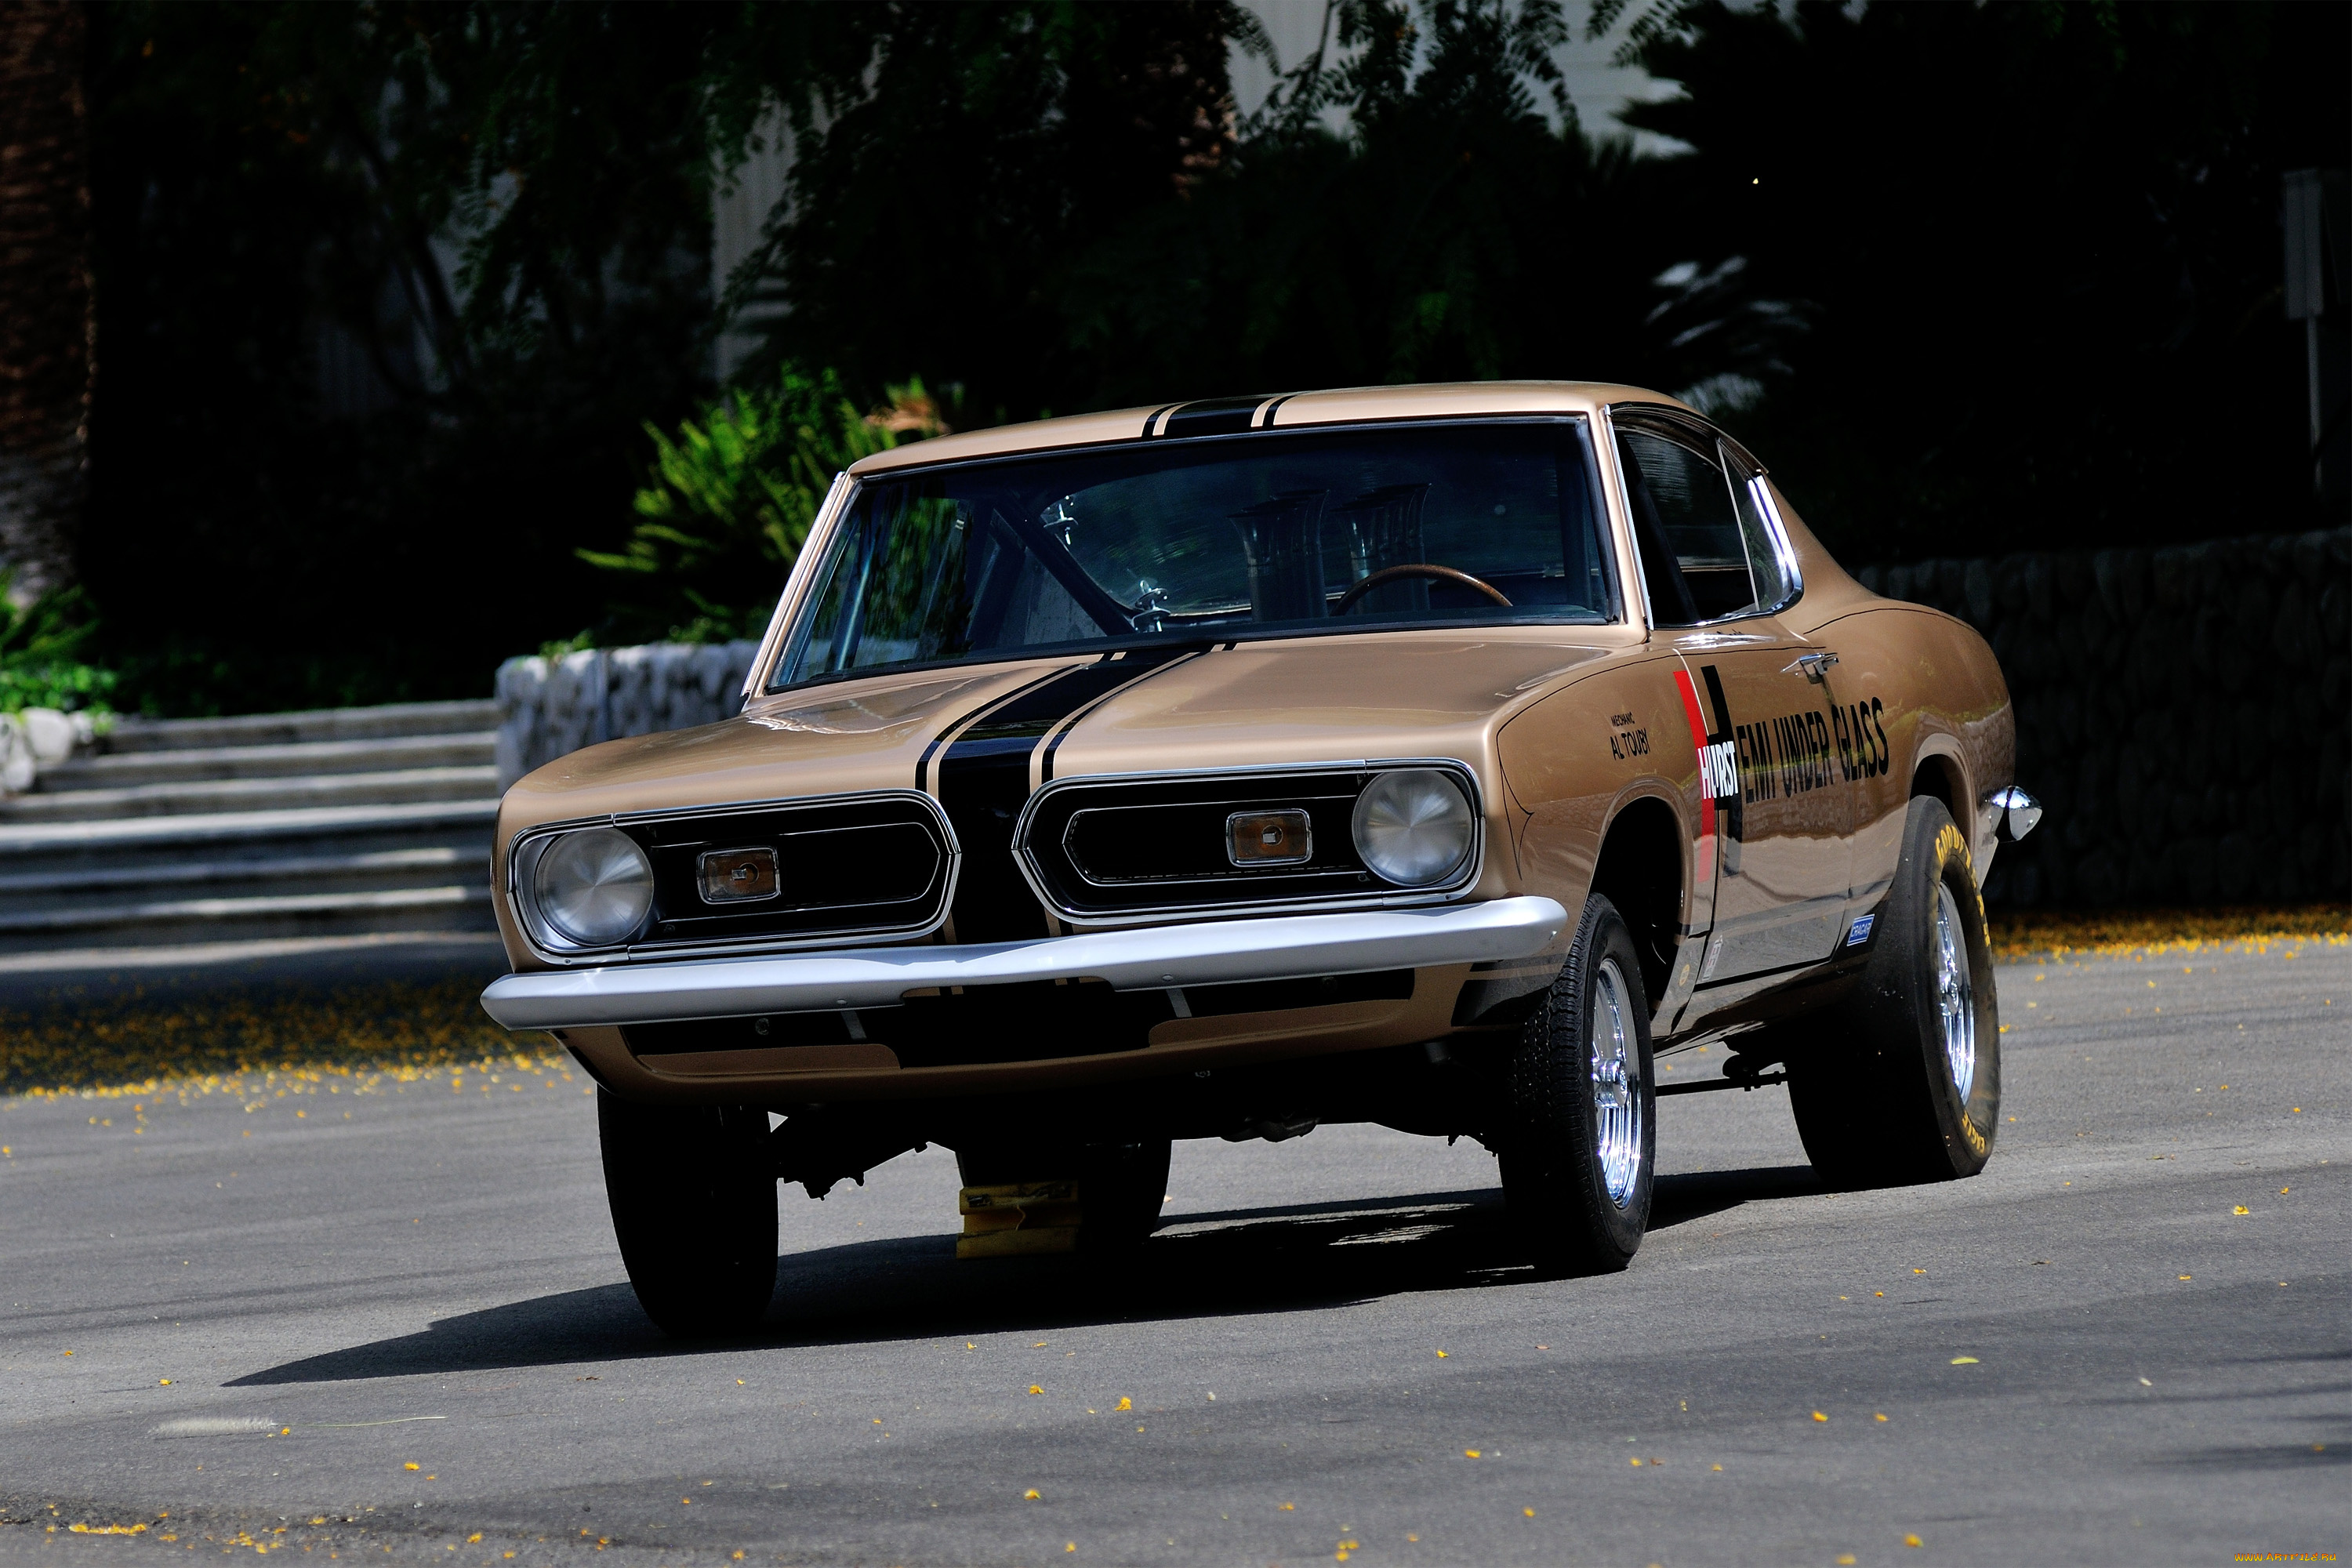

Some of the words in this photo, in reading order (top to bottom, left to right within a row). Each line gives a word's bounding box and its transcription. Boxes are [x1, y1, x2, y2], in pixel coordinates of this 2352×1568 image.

[1610, 735, 1625, 760] AL
[1621, 728, 1651, 757] TOUBY
[1697, 740, 1739, 800] HURST
[1773, 710, 1835, 798] UNDER
[1831, 695, 1890, 783] GLASS
[1962, 1110, 1986, 1154] EAGLE
